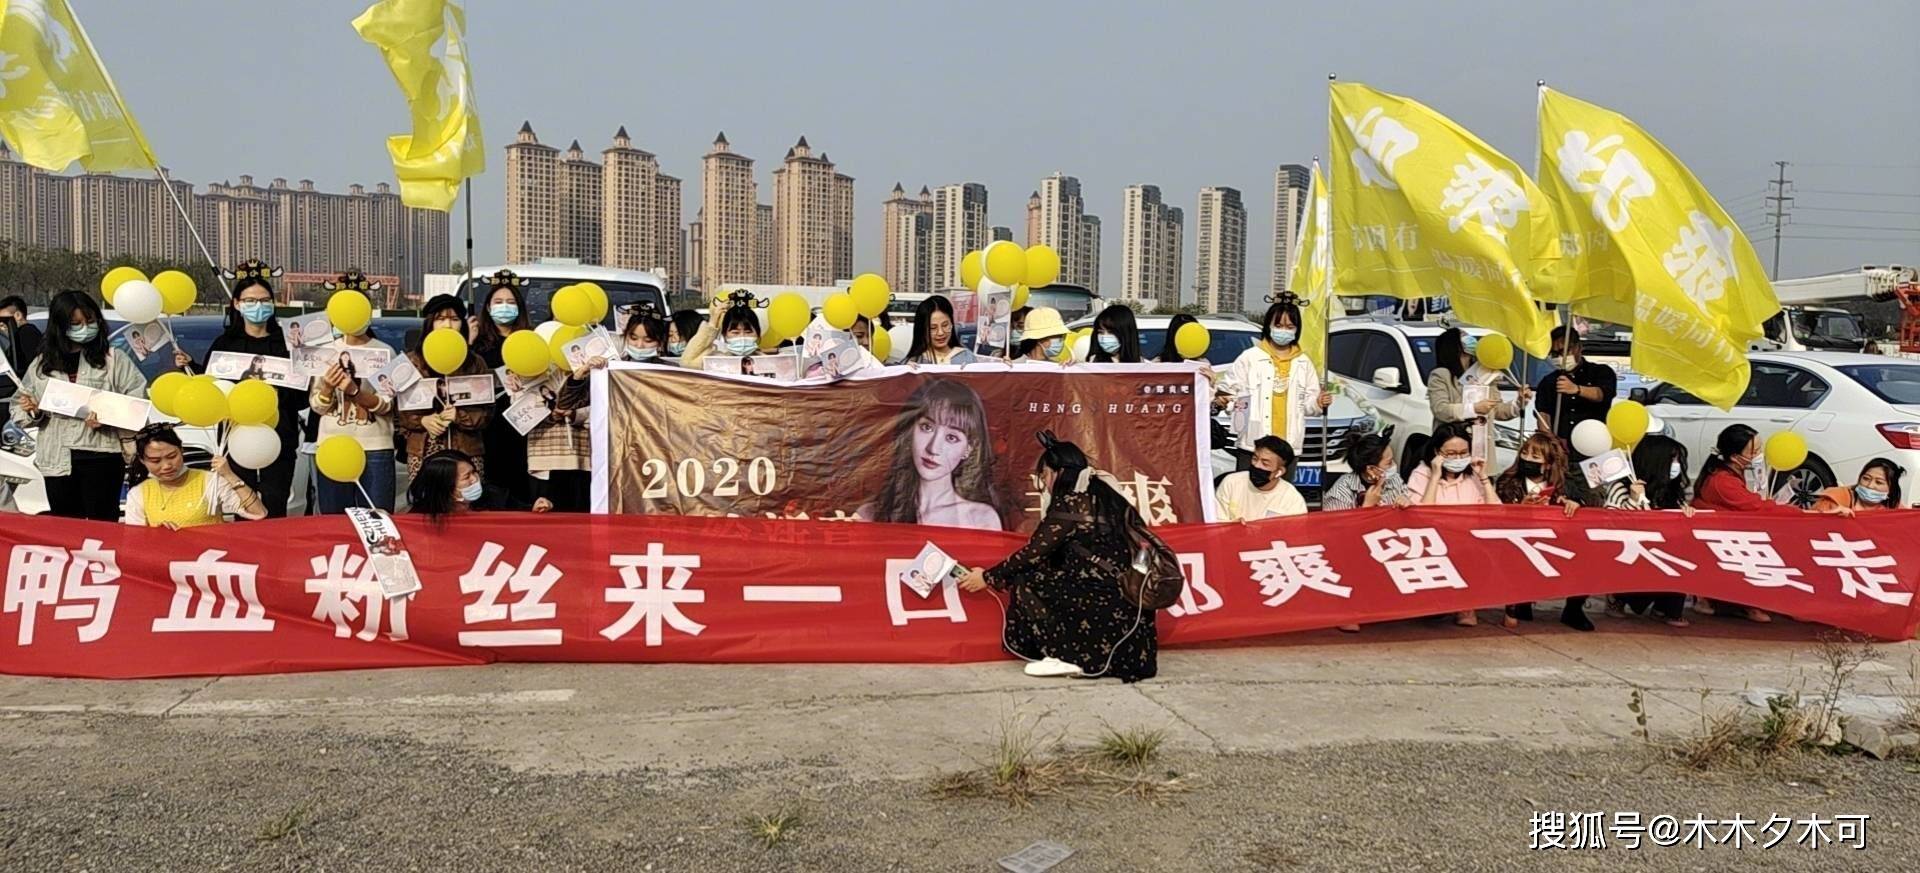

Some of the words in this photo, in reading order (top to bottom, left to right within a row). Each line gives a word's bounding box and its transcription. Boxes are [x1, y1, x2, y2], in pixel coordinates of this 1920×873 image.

[641, 456, 777, 499] 2020
[3, 538, 969, 647] 鸭血粉丝来一口
